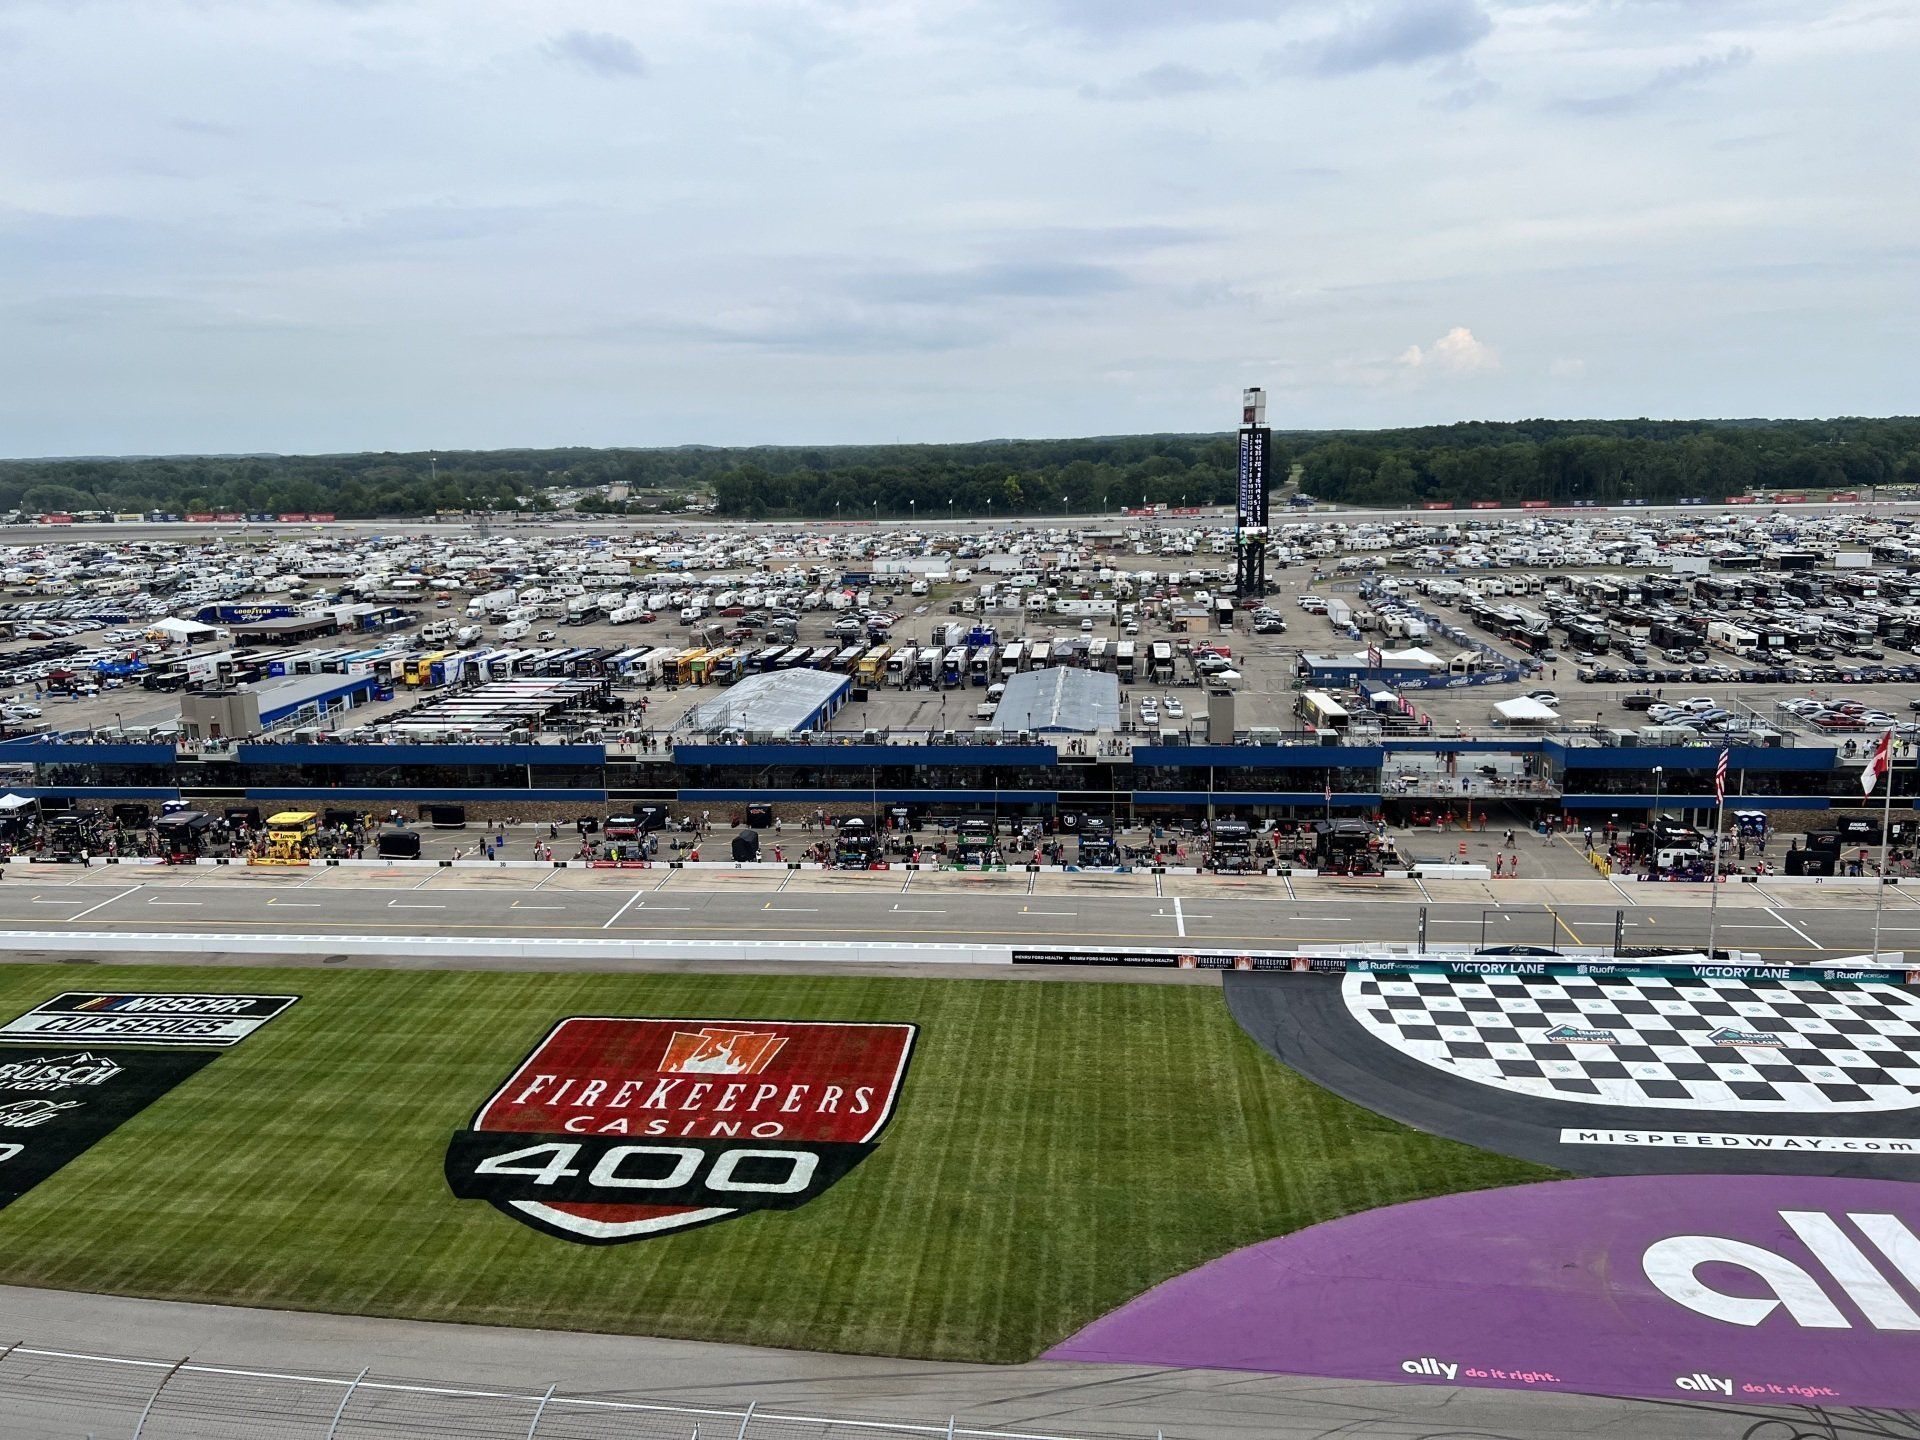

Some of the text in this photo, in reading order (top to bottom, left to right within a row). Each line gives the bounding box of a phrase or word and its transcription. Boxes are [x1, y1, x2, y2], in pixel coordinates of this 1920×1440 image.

[1370, 962, 1395, 970] Ruoff
[1452, 963, 1545, 974] VICTORY LANE
[1589, 965, 1615, 974] Ruoff
[1692, 966, 1790, 979] VICTORY LANE
[1836, 971, 1864, 979] Ruoff
[117, 997, 257, 1013] NASCAR
[36, 1018, 234, 1034] CUP SERIES
[0, 1064, 126, 1086] BUSCH
[512, 1074, 876, 1114] FIREKEEPERS
[564, 1116, 784, 1138] CASINO
[1579, 1132, 1914, 1152] MISPEEDWAY.com
[474, 1142, 820, 1194] 400
[1402, 1357, 1560, 1384] ally do it right.
[1676, 1373, 1840, 1398] ally do it right.
